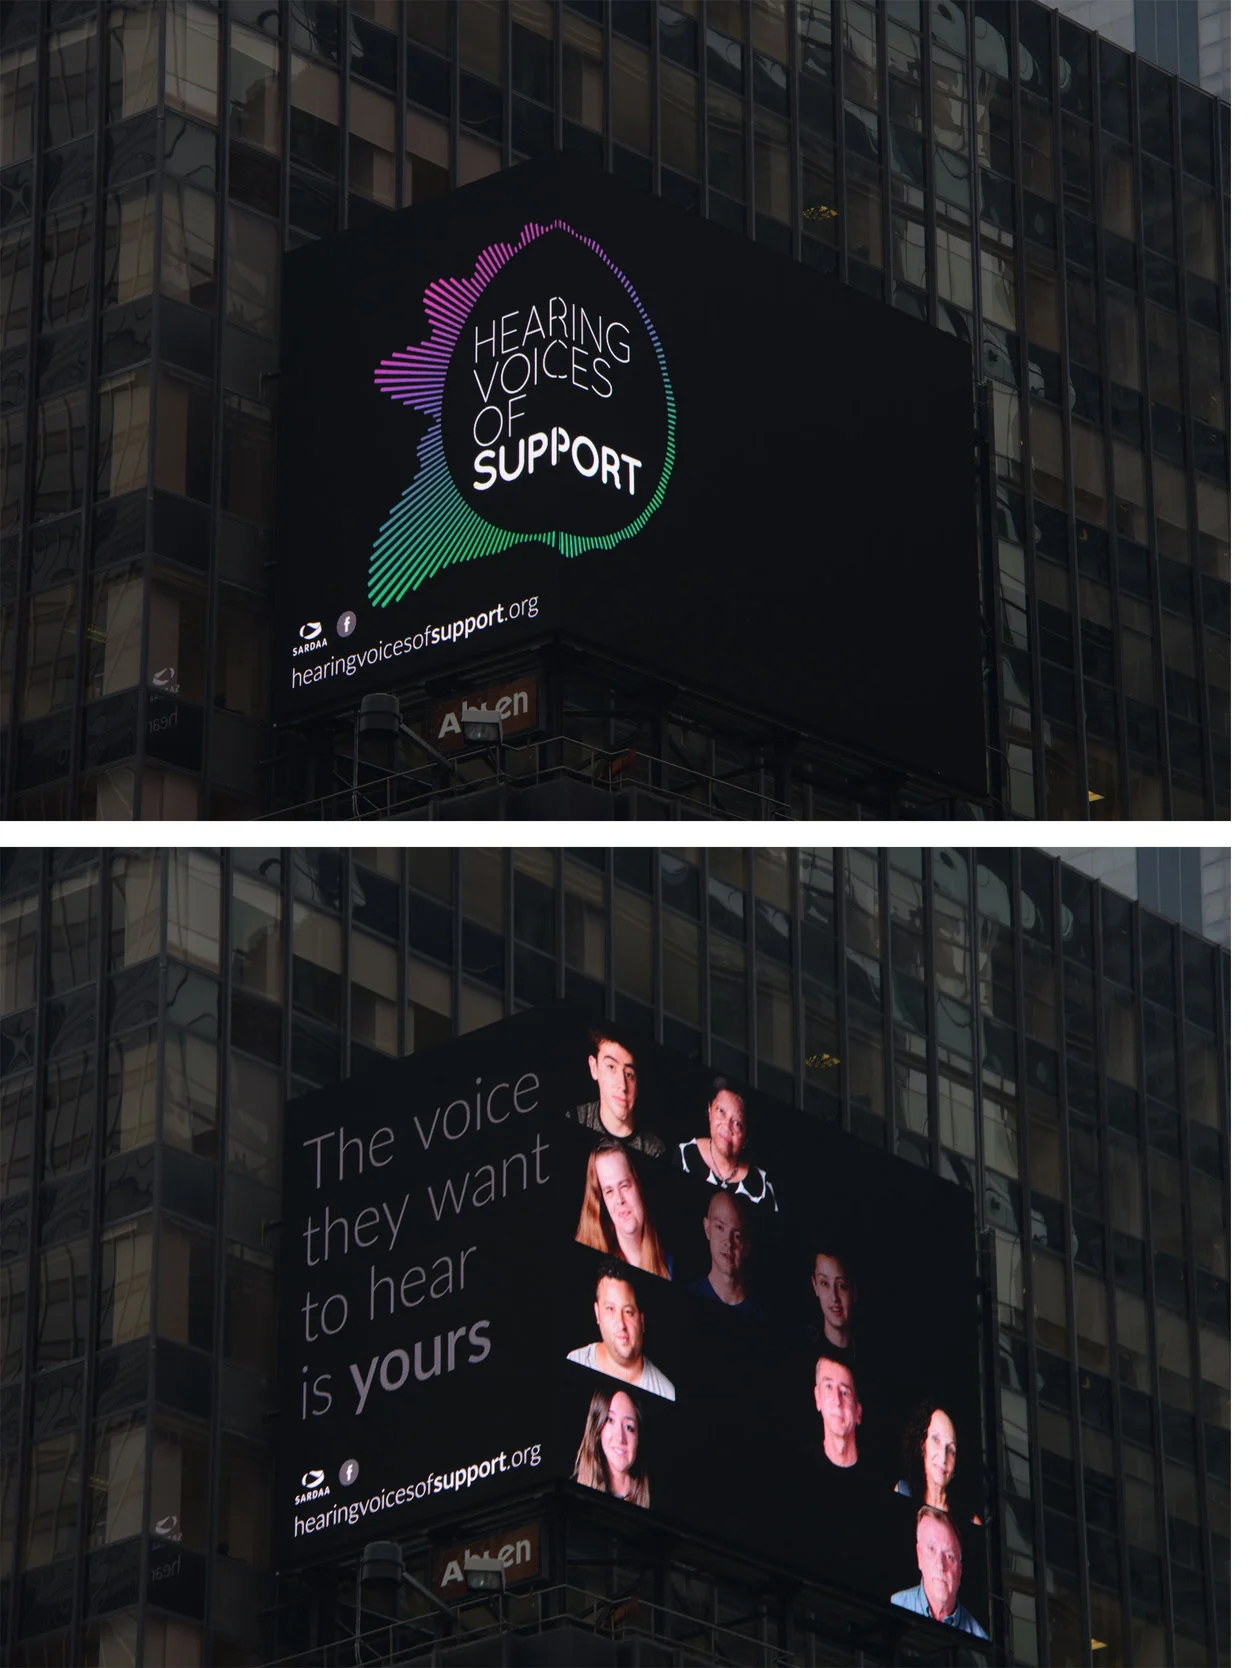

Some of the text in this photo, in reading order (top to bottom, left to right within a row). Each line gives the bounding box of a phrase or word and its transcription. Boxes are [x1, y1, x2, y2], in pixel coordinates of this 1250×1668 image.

[474, 296, 631, 364] HEARING
[473, 339, 613, 404] VOICES
[472, 426, 643, 496] SUPPORT
[473, 393, 527, 447] OF
[291, 595, 539, 689] hearingvoicesofsupport.org
[292, 637, 328, 657] SARDAA
[302, 1072, 540, 1189] The voice
[302, 1133, 550, 1267] they want
[300, 1246, 477, 1342] to hear
[302, 1319, 492, 1421] is yours
[294, 1443, 542, 1538] hearingvoicesofsupport.org
[294, 1485, 331, 1506] SARDAA
